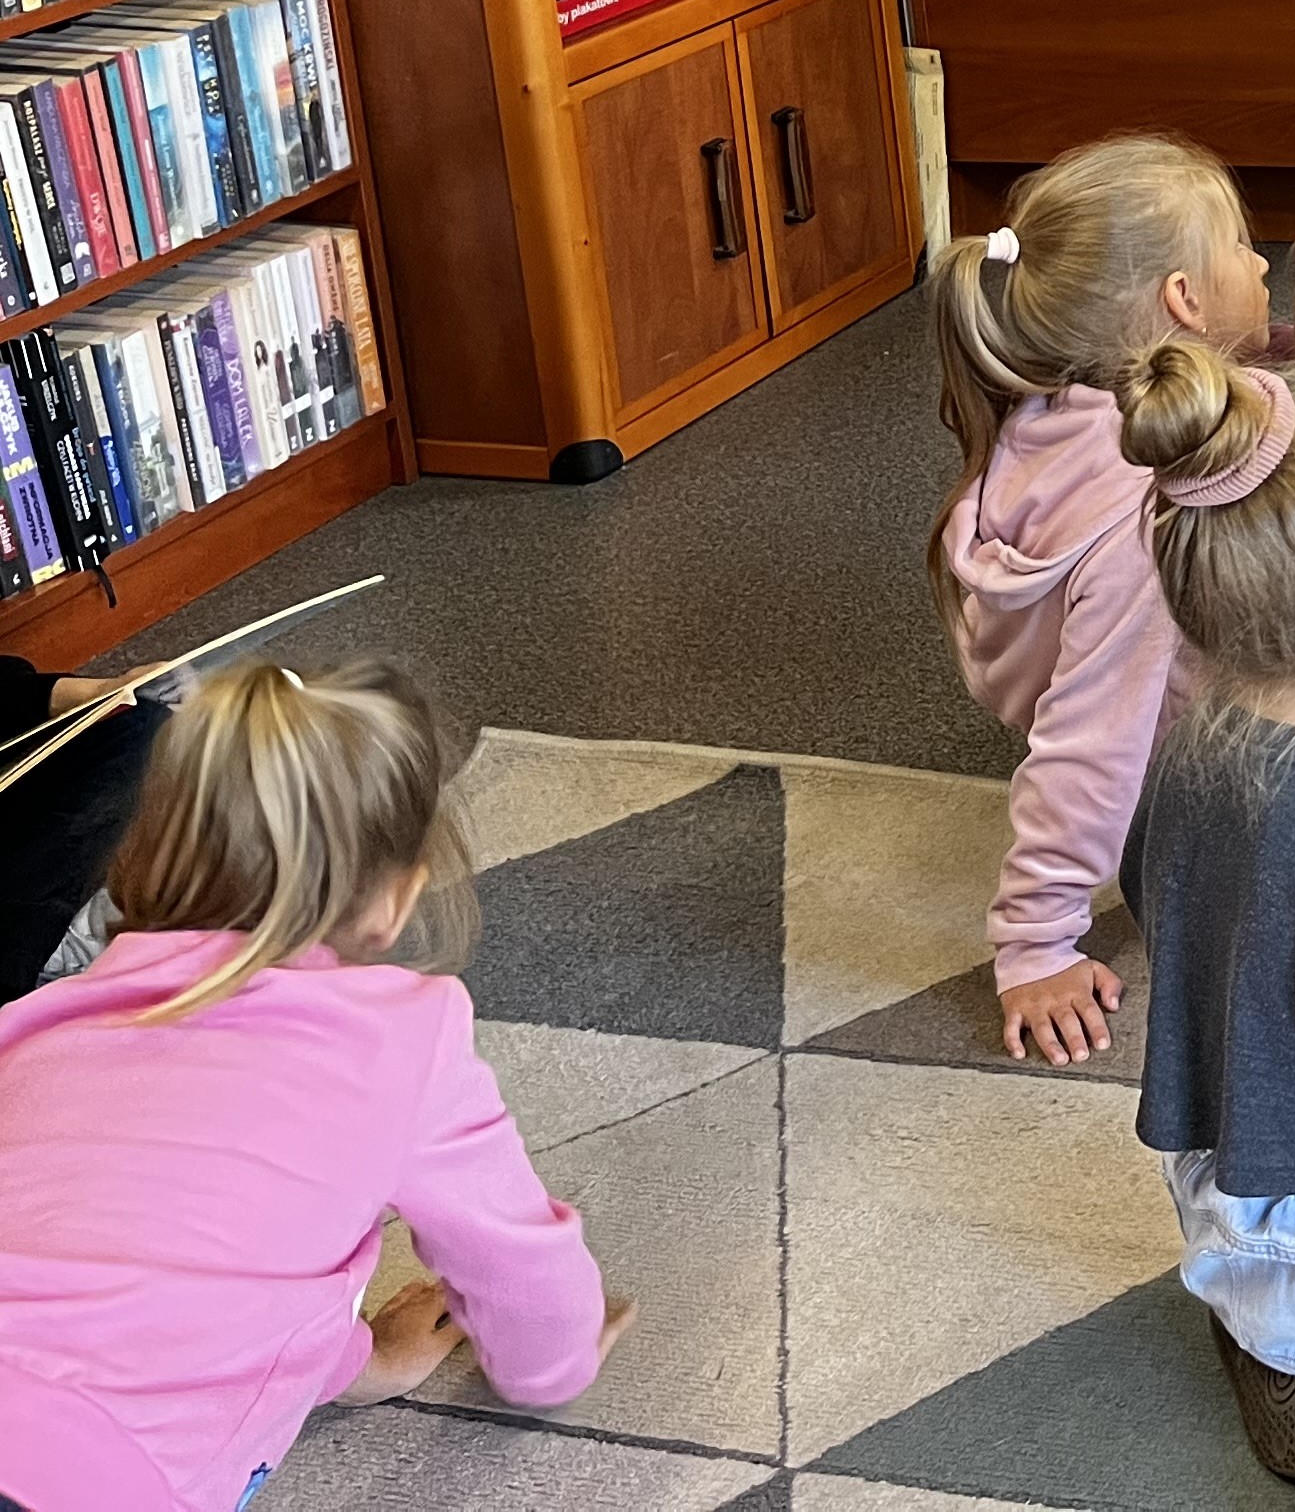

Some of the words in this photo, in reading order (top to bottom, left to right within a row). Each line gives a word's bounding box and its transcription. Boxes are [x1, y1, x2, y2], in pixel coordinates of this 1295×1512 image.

[292, 0, 311, 37] MOC
[300, 41, 321, 86] KRWI
[21, 99, 43, 156] ROZPALASZ
[41, 180, 56, 209] SERCE
[321, 243, 334, 272] DELIA
[325, 274, 340, 312] OWENS
[352, 316, 374, 350] LATA
[223, 358, 243, 396] DOM
[0, 377, 20, 432] JAKUB
[231, 397, 256, 448] LALEK
[17, 485, 40, 547] ZWROTNA
[26, 480, 53, 560] INFORMACJA
